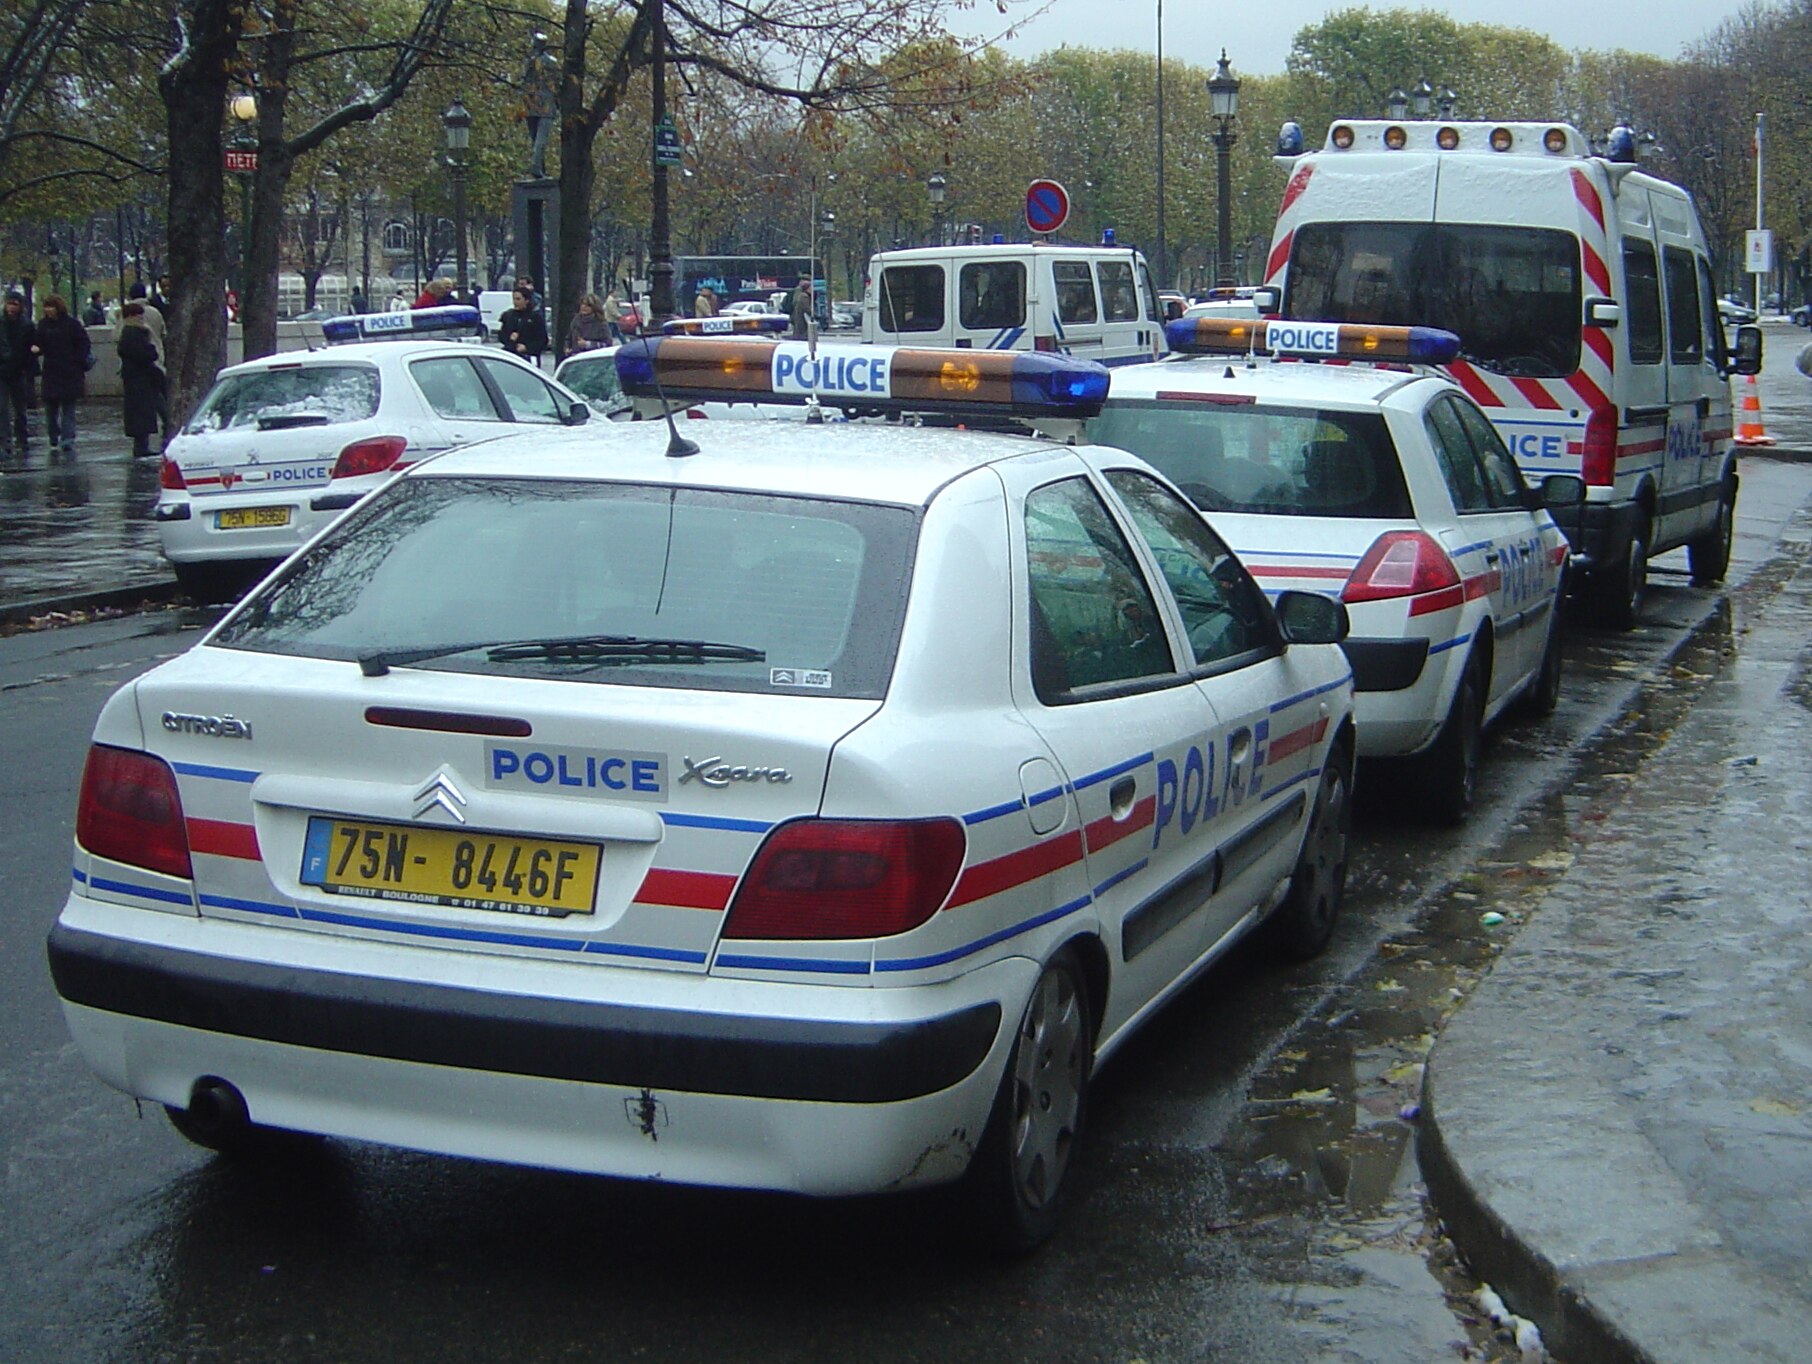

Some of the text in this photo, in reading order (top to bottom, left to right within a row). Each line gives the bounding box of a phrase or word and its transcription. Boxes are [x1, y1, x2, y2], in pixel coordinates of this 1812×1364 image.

[371, 315, 405, 329] POLICE
[704, 320, 732, 331] POLICE
[1269, 328, 1335, 350] POLICE
[776, 354, 885, 392] POLICE
[1509, 434, 1562, 458] ICE
[273, 467, 326, 481] POLICE
[492, 749, 660, 792] POLICE
[677, 755, 793, 789] Xsara
[1152, 718, 1269, 850] POLICE
[310, 857, 321, 871] F
[452, 840, 580, 900] 8446F
[382, 890, 440, 903] BOULOGNE
[463, 899, 477, 907] 01
[481, 901, 496, 909] 47
